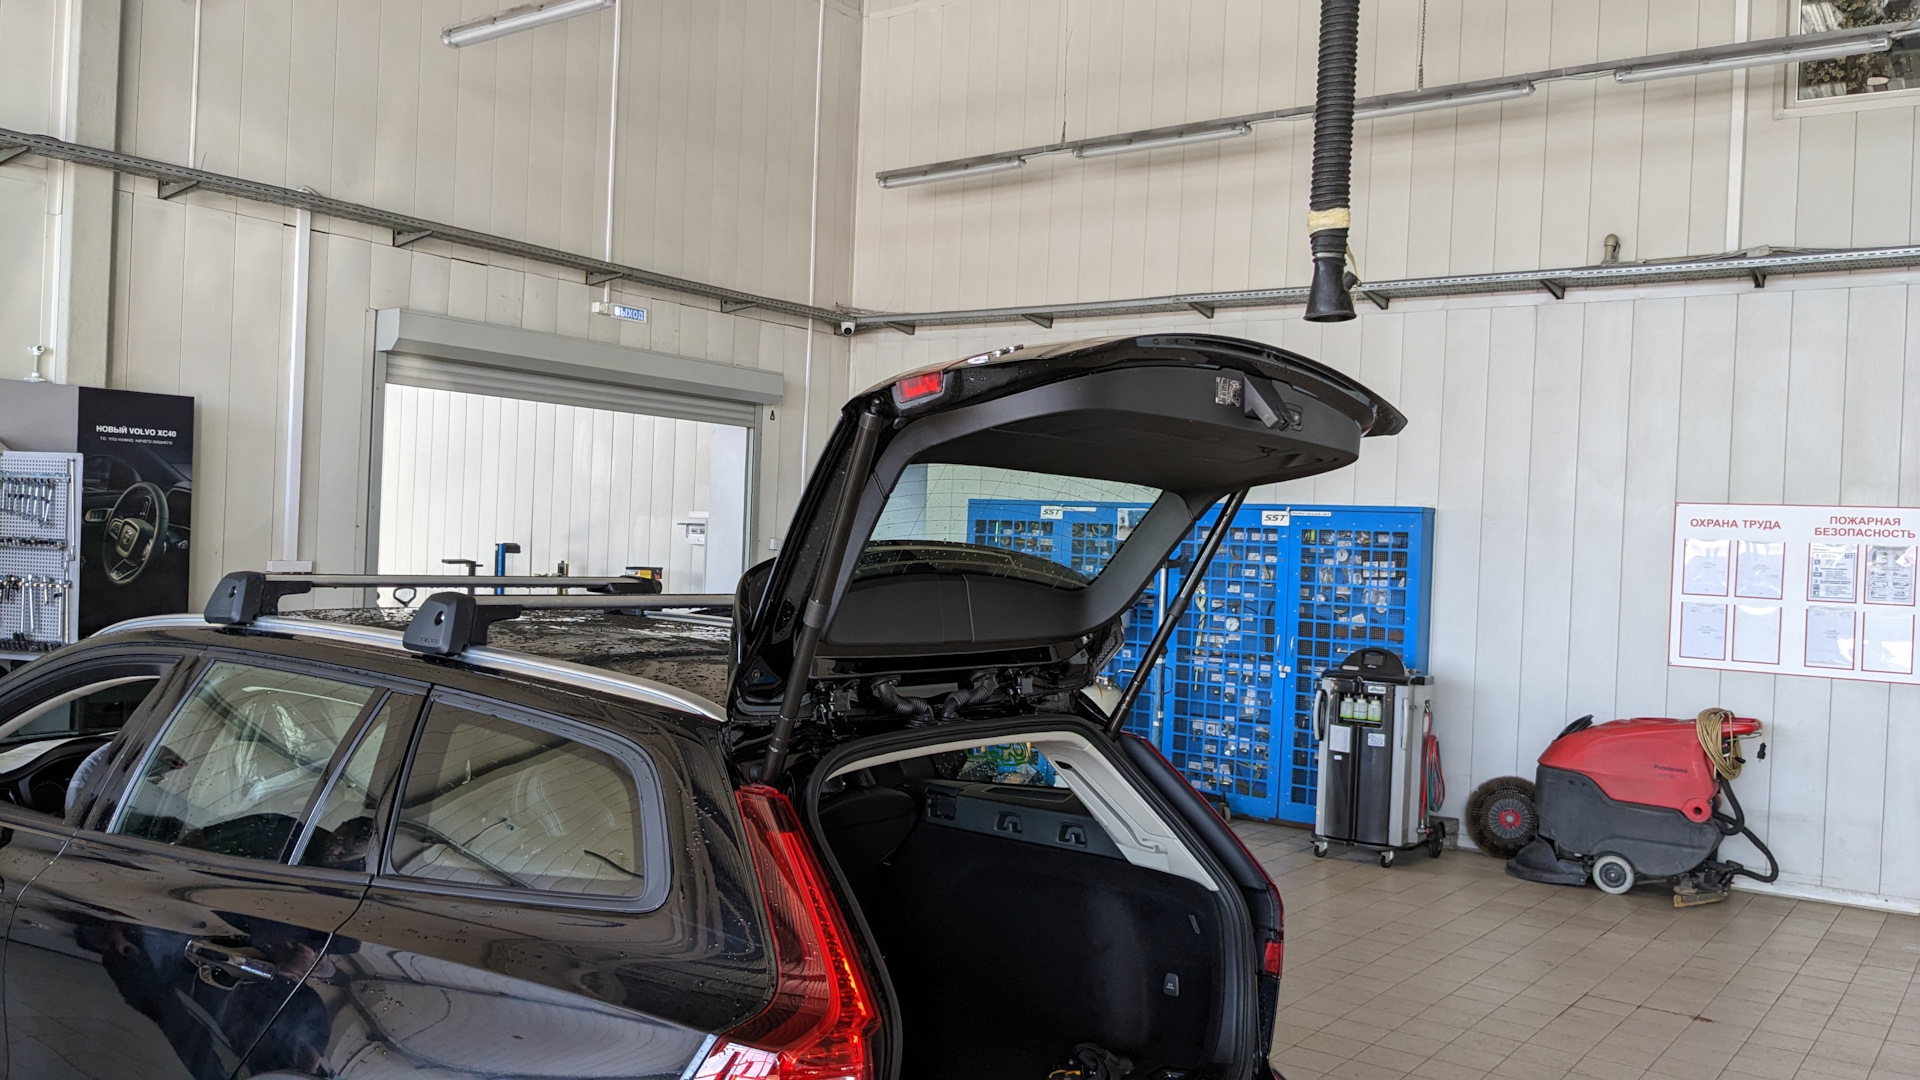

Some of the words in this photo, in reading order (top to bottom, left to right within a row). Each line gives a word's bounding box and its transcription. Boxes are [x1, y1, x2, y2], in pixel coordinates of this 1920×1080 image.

[614, 306, 644, 320] ВЫХОД
[96, 425, 127, 434] НОВЫЙ
[129, 427, 156, 436] VOLVO
[157, 429, 177, 438] XC40
[1042, 508, 1060, 516] SST
[1264, 514, 1288, 522] SST
[1829, 516, 1901, 526] ПОЖАРНАЯ
[1690, 518, 1738, 528] ОХРАНА
[1742, 520, 1781, 531] ТРУДА
[1814, 527, 1916, 538] БЕЗОПАСНОСТЬ
